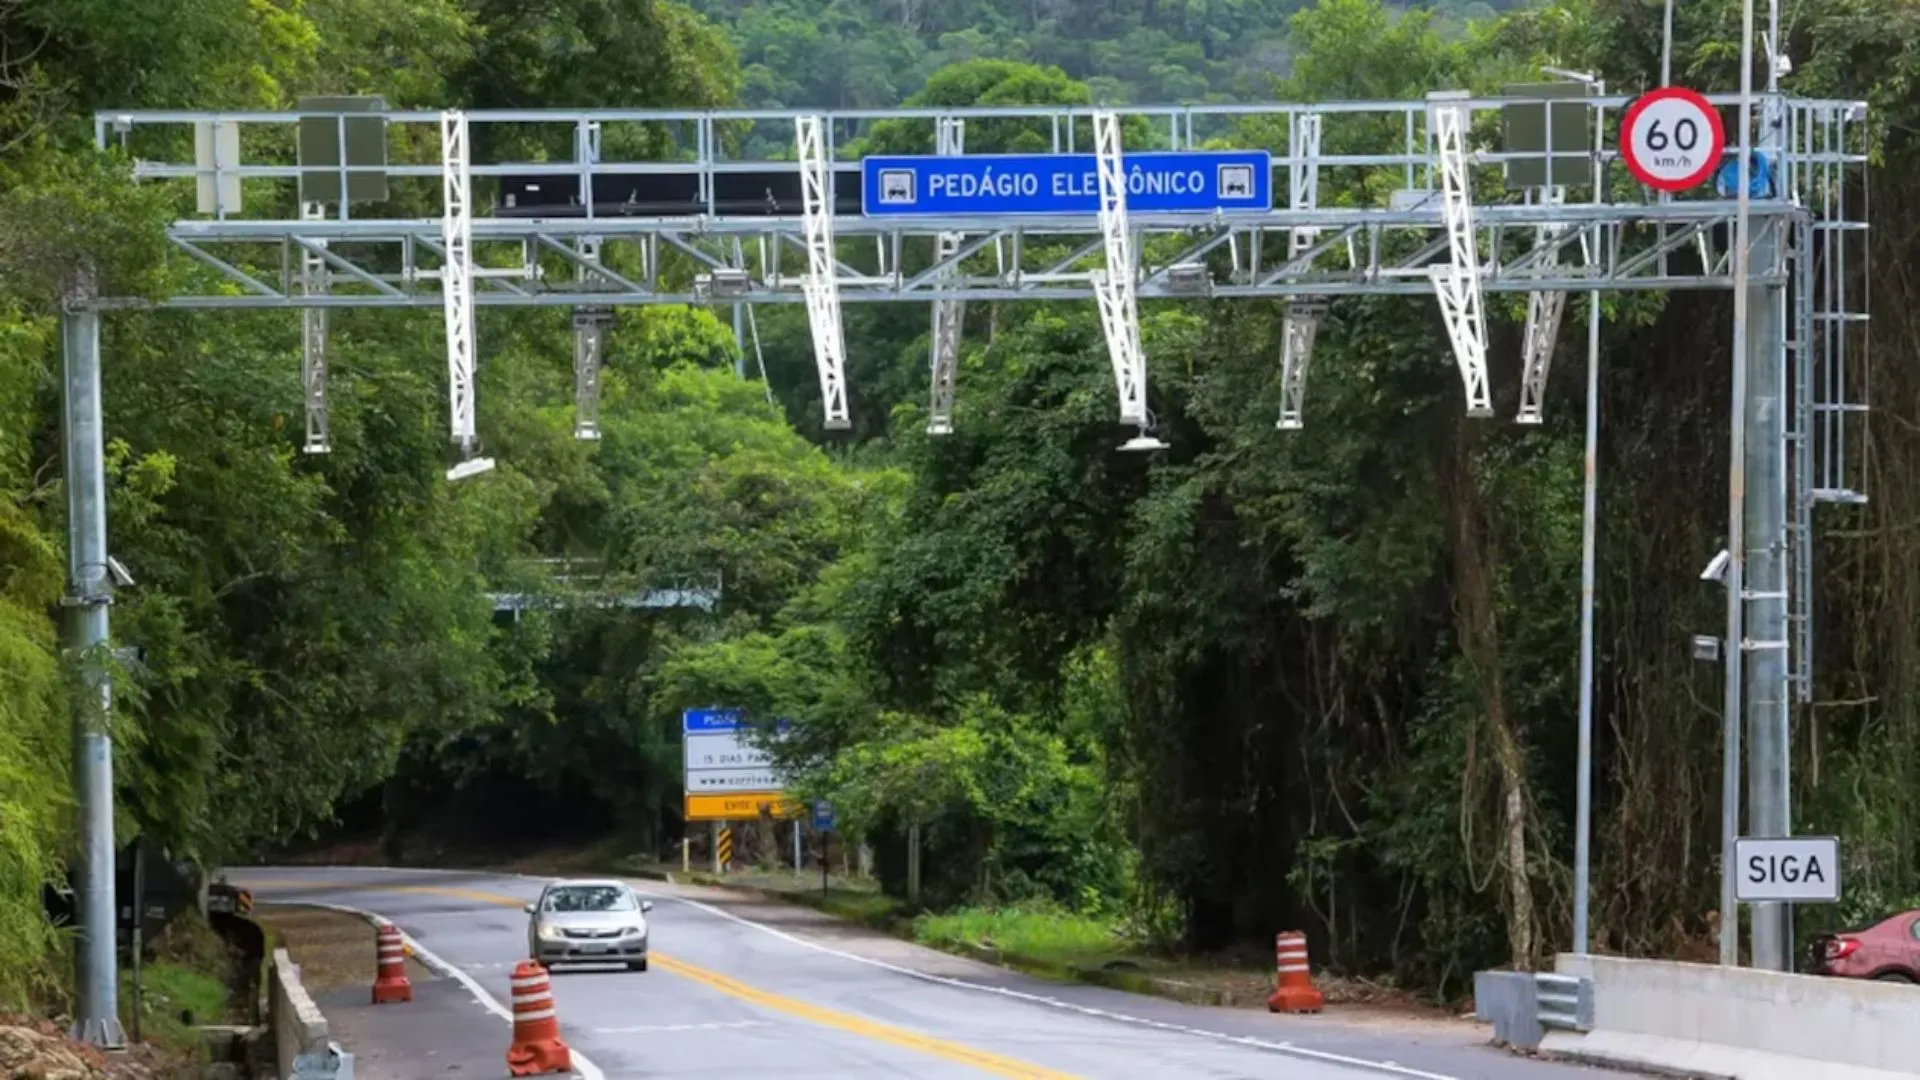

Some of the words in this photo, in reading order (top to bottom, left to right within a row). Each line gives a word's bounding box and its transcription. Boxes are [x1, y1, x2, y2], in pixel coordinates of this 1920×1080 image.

[1646, 118, 1698, 151] 60
[1653, 155, 1692, 168] km/h
[928, 166, 1038, 197] PEDÁGIO
[1052, 164, 1205, 196] ELERÔNICO
[1748, 854, 1825, 883] SIGA
